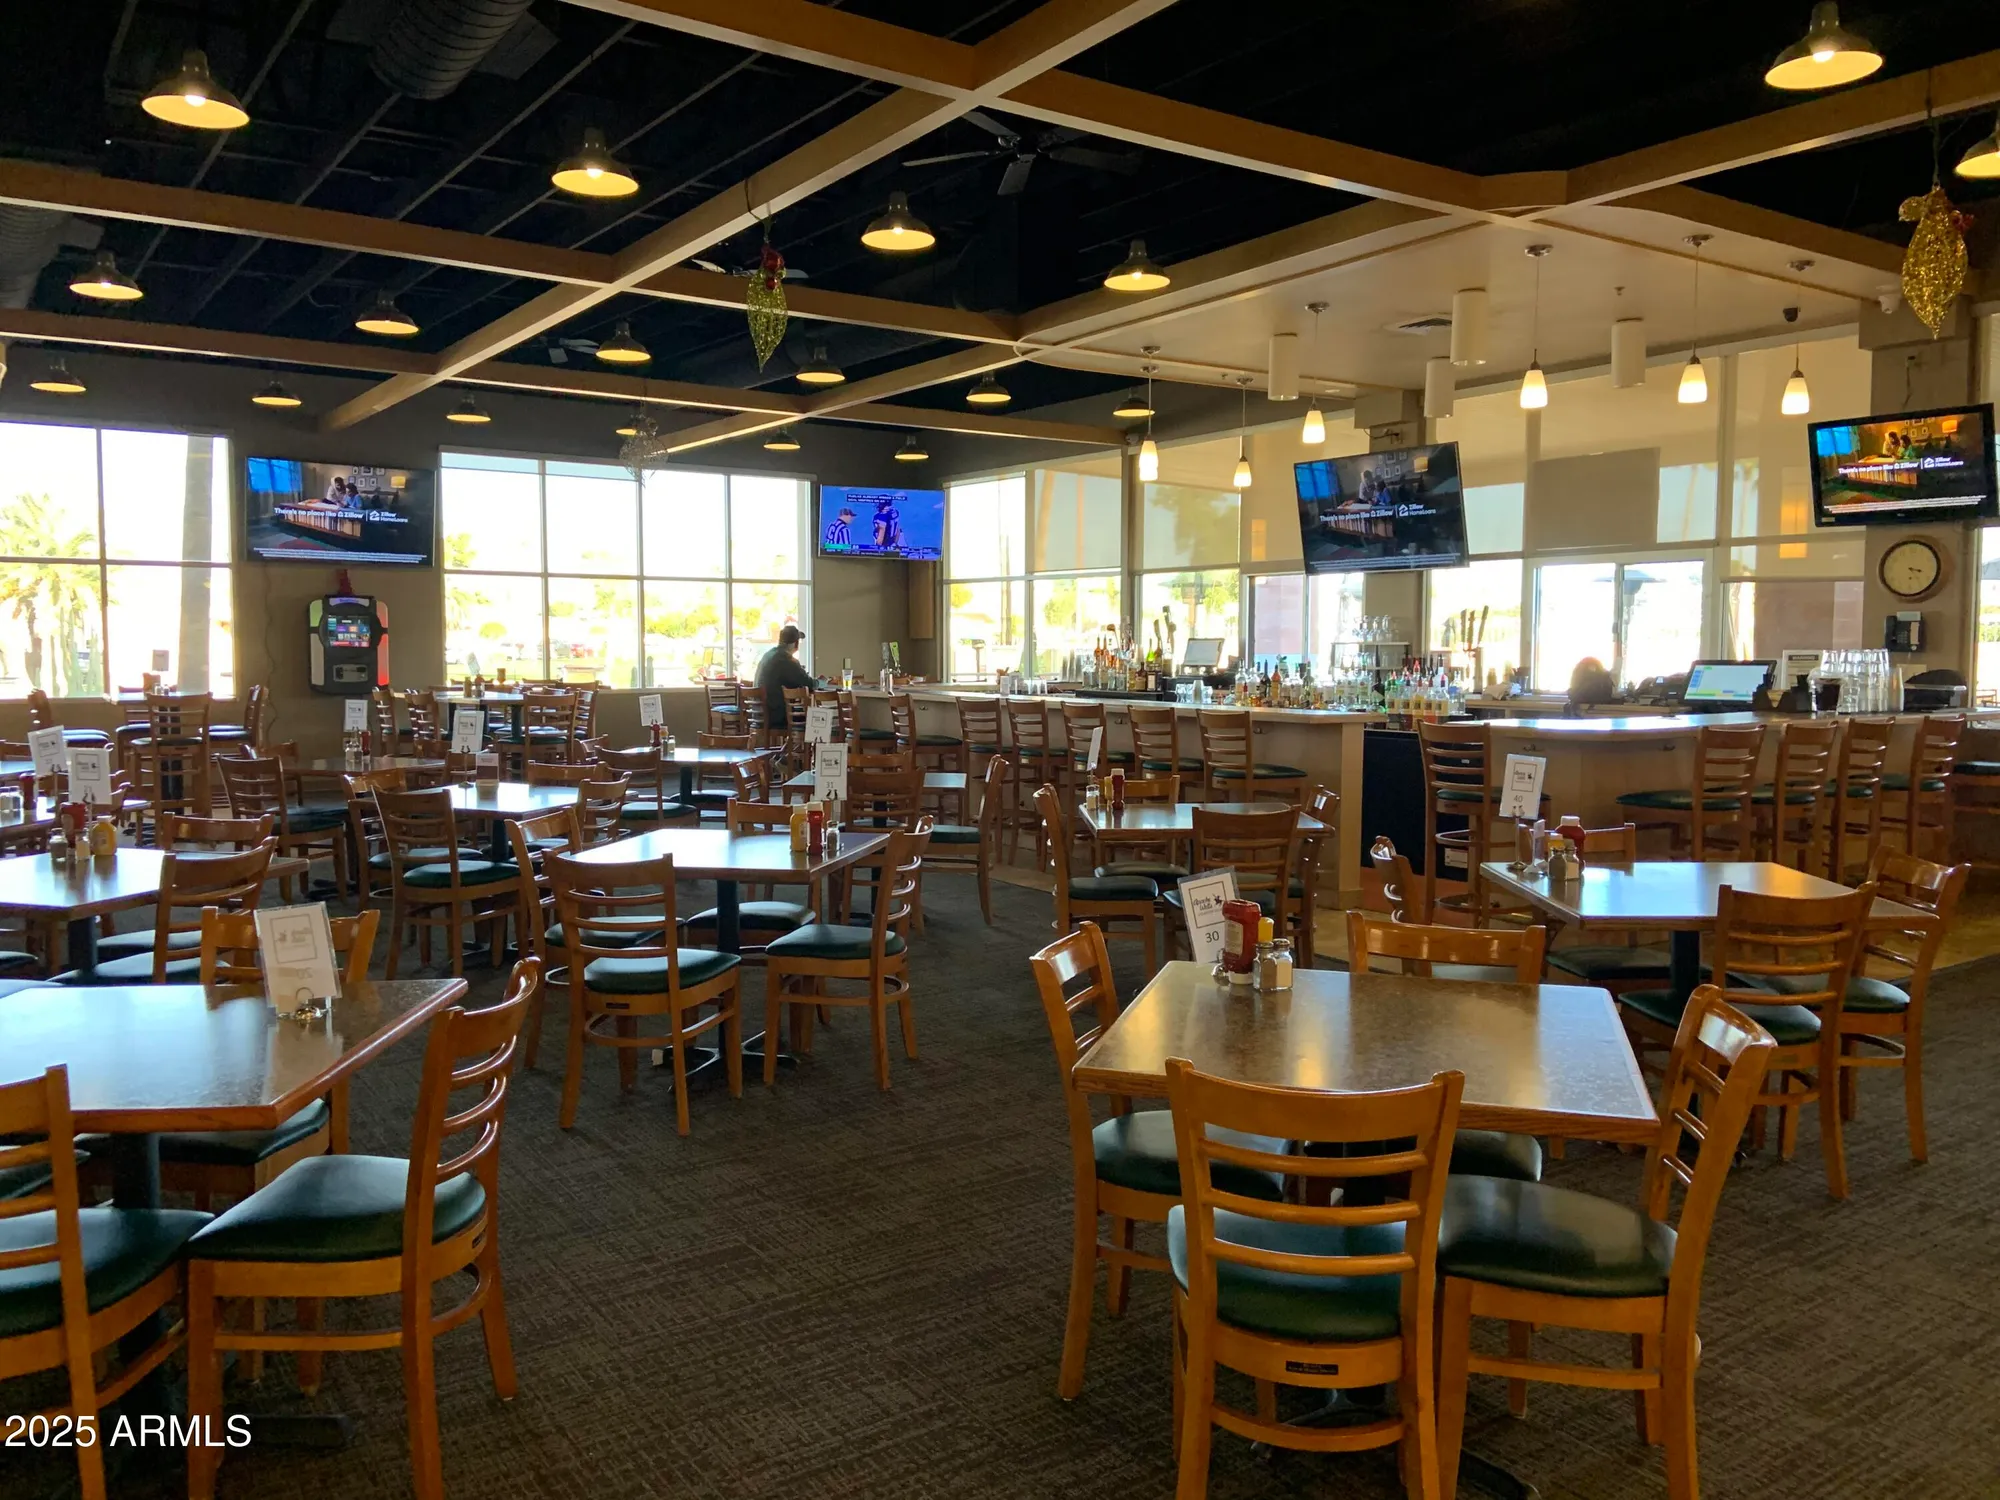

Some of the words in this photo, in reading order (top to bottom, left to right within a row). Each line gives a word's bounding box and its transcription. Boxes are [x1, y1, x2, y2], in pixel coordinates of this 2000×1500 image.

[1900, 462, 1919, 470] Zillow
[274, 507, 298, 516] There's
[344, 511, 364, 519] Zillow
[1319, 514, 1338, 522] There's
[1376, 509, 1394, 518] Zillow
[1205, 930, 1220, 943] 30
